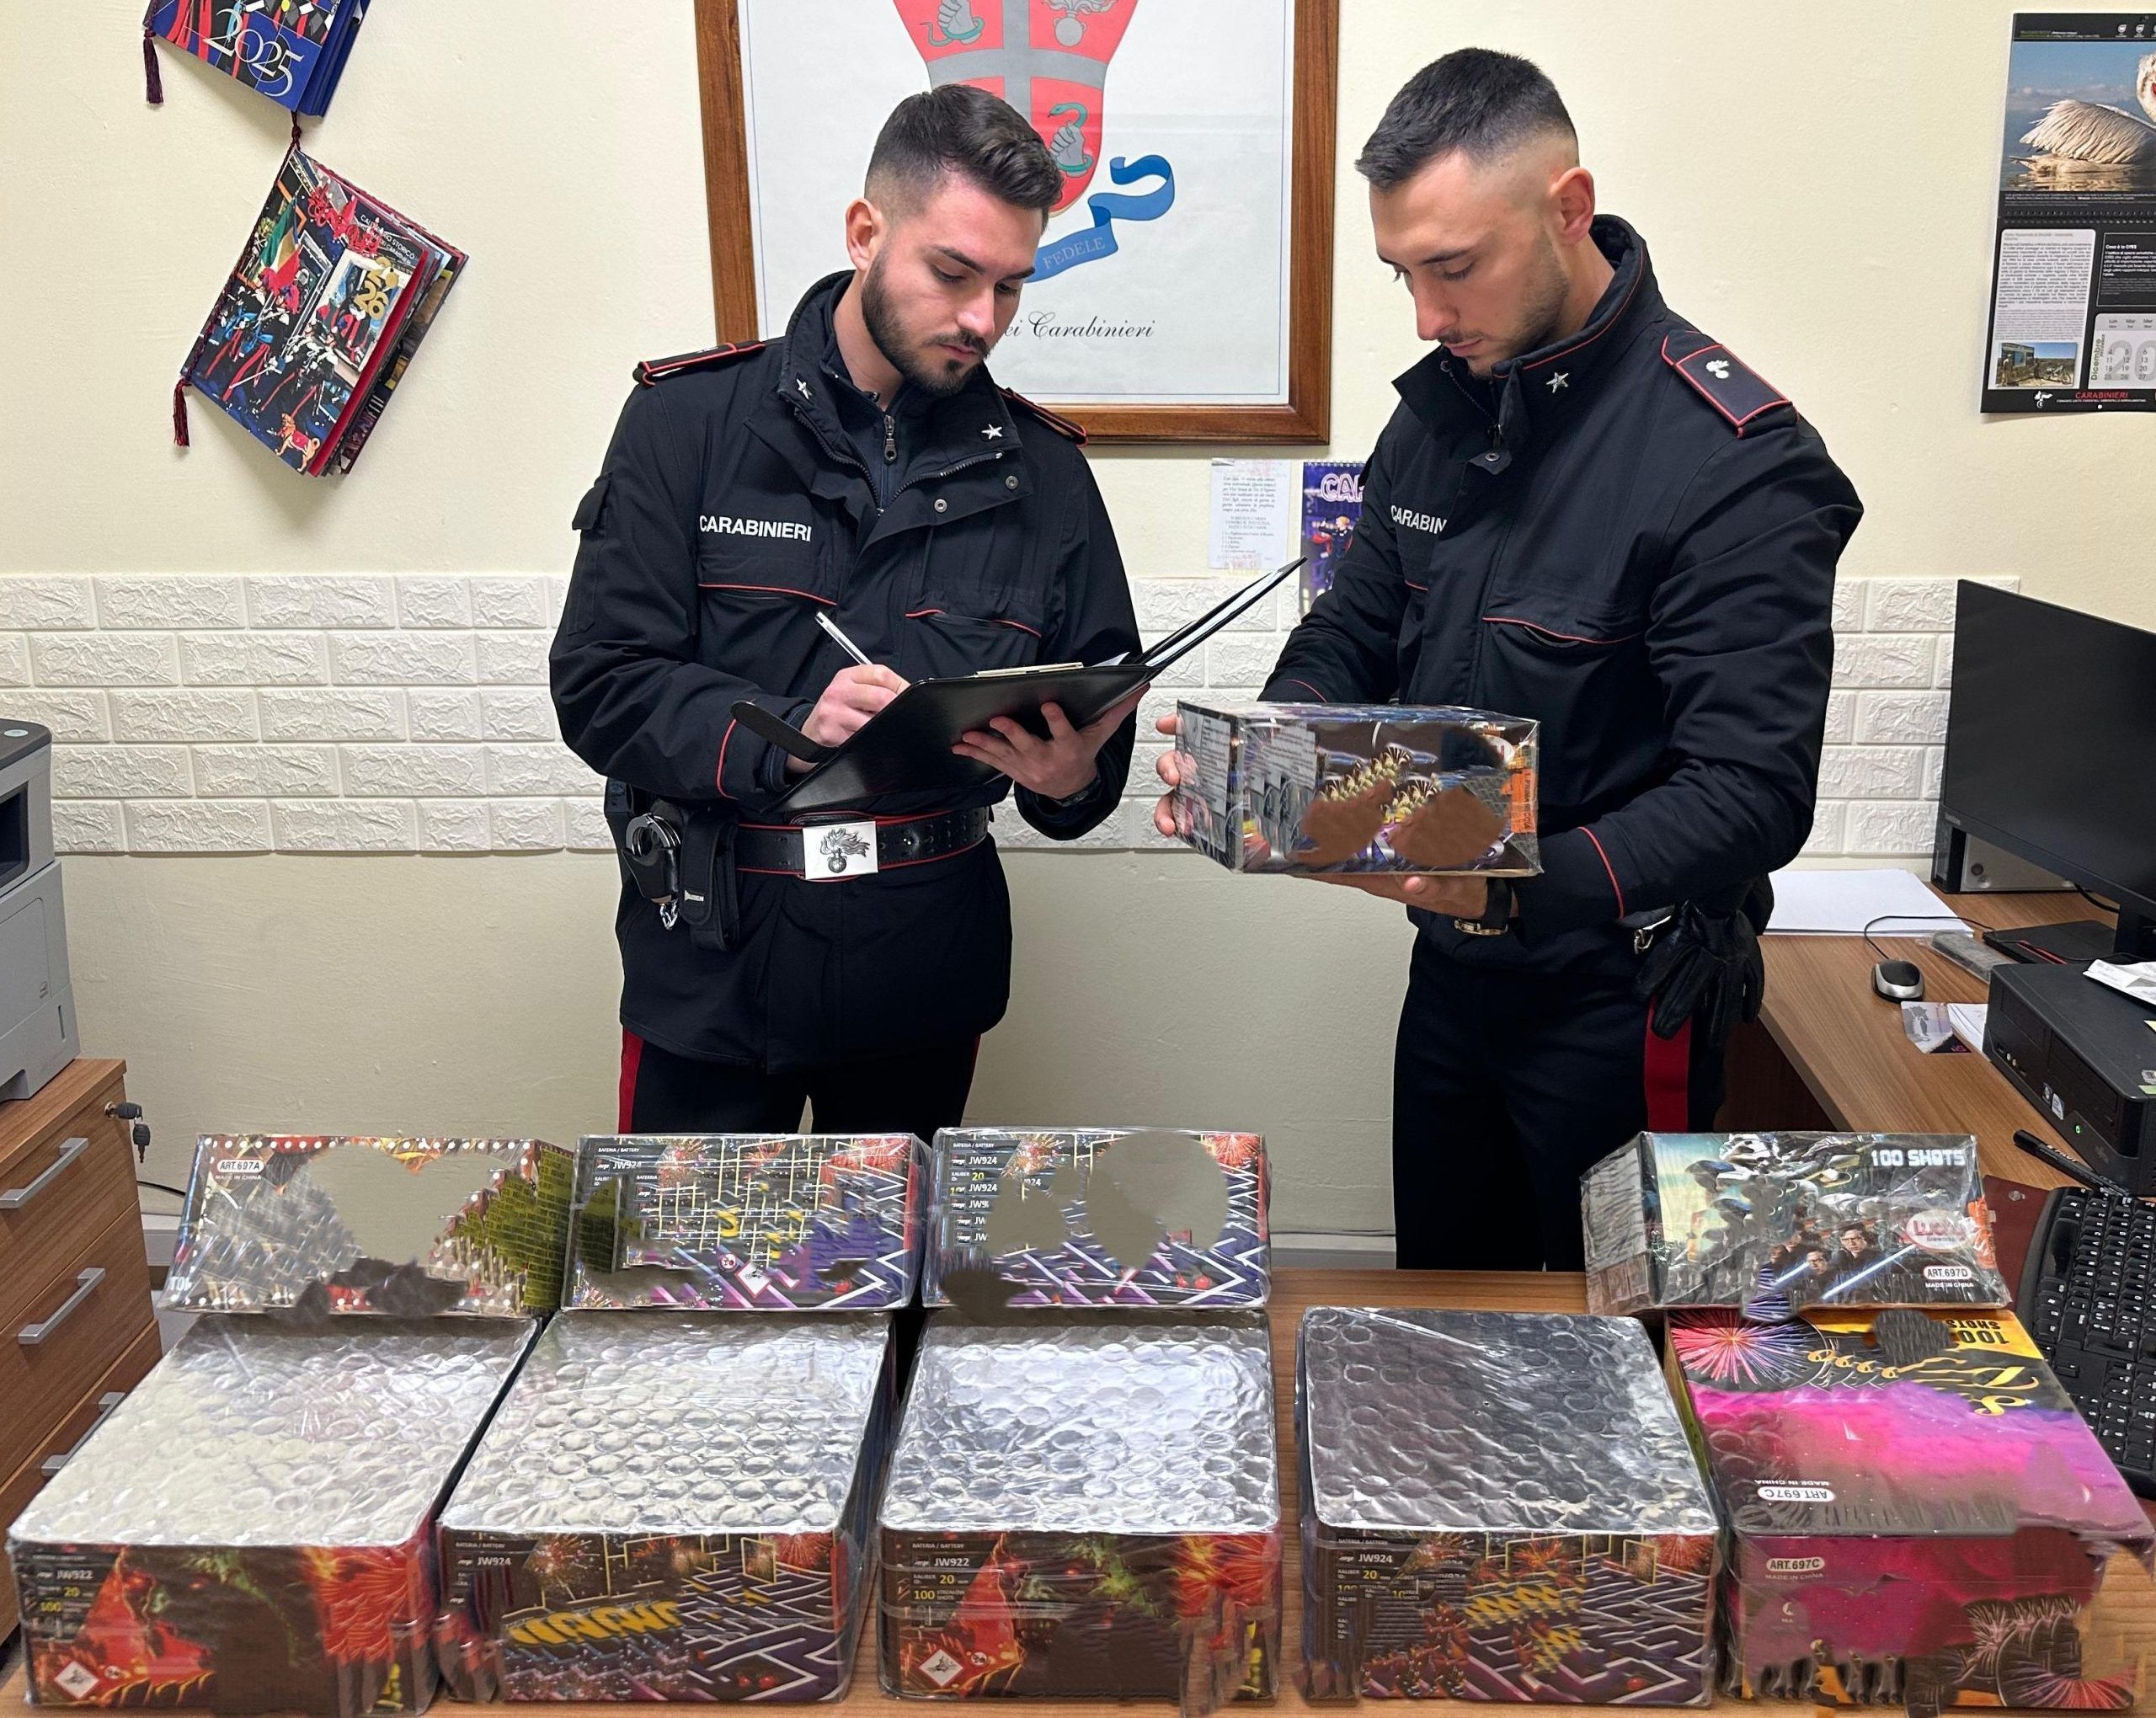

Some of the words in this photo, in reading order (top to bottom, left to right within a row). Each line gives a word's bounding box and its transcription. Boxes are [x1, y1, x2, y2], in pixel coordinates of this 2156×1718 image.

[203, 8, 304, 97] 2025
[392, 238, 415, 259] STORICO
[1043, 237, 1106, 270] FEDELE
[354, 280, 389, 319] 26
[1003, 319, 1023, 338] ei
[1028, 310, 1155, 340] Carabinieri
[699, 515, 812, 542] CARABINIERI
[969, 1156, 997, 1165] JW924
[1871, 1150, 1903, 1166] 100
[1907, 1150, 1966, 1166] SHOTS
[972, 1171, 985, 1182] 20
[969, 1183, 997, 1192] JW924
[1945, 1319, 2001, 1330] SHOTS
[1956, 1330, 2009, 1345] 100
[477, 1556, 511, 1566] JW924
[934, 1557, 969, 1566] JW922
[1358, 1553, 1394, 1563] JW924
[939, 1574, 955, 1584] 20
[1363, 1570, 1377, 1580] 20
[914, 1590, 936, 1600] 100
